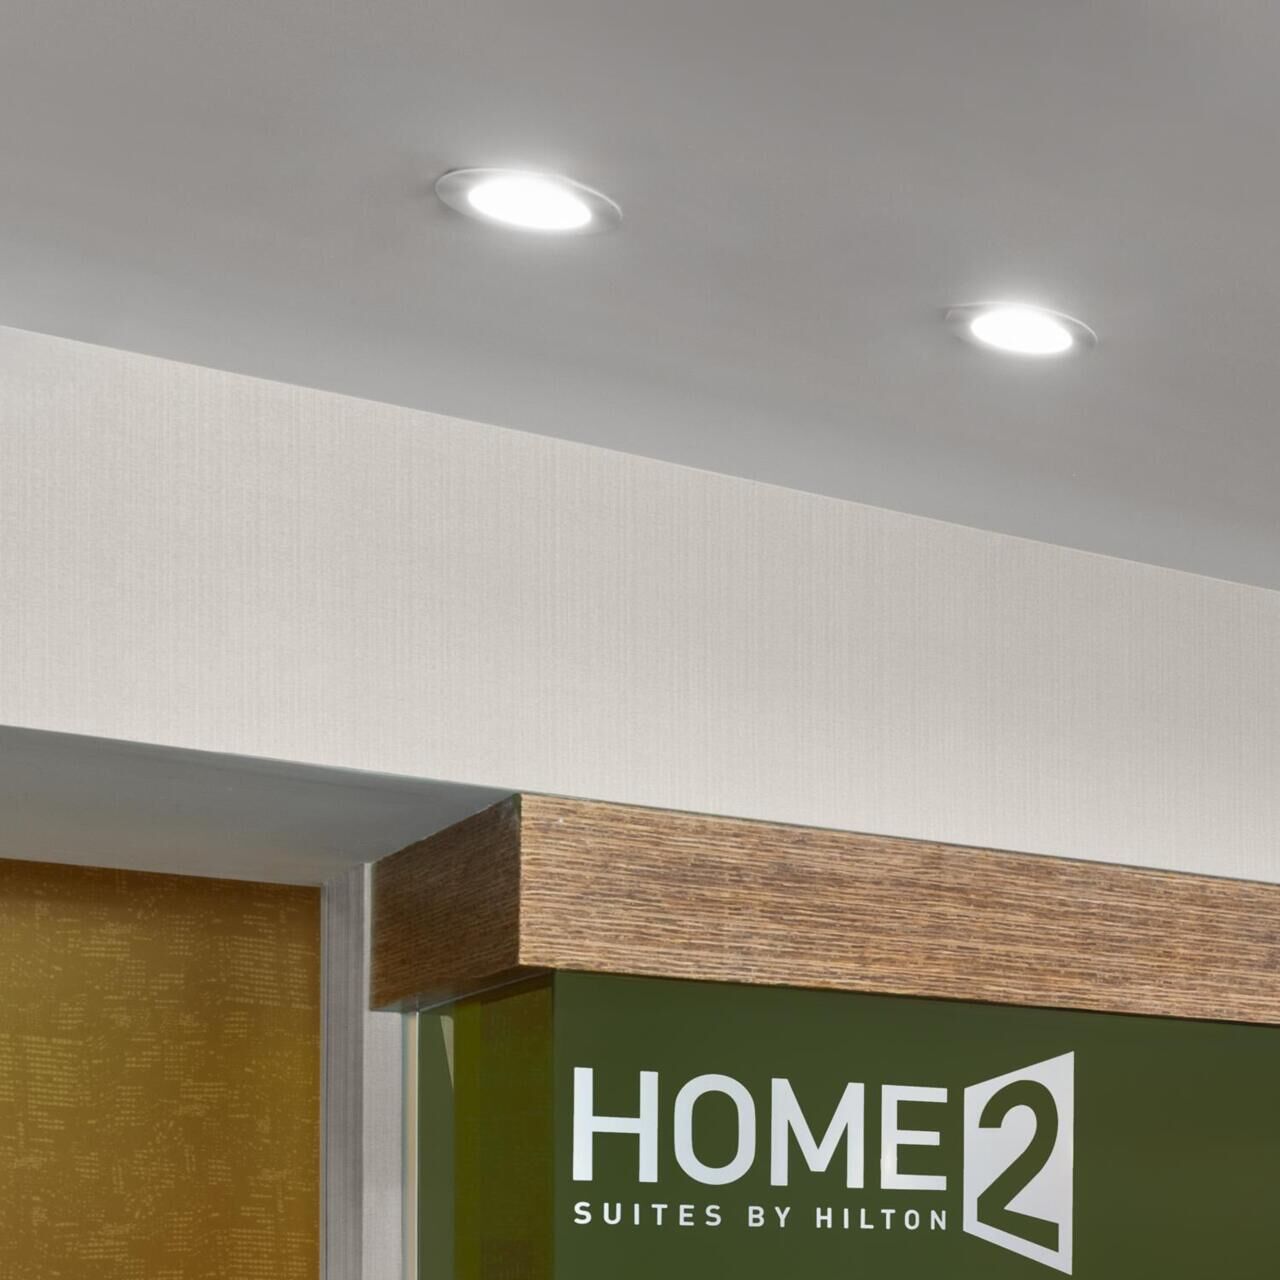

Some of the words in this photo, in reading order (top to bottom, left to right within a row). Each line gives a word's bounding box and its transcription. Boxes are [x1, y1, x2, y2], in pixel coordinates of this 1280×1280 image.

[573, 1202, 722, 1227] SUITES
[748, 1206, 791, 1228] BY
[815, 1208, 947, 1231] HILTON
